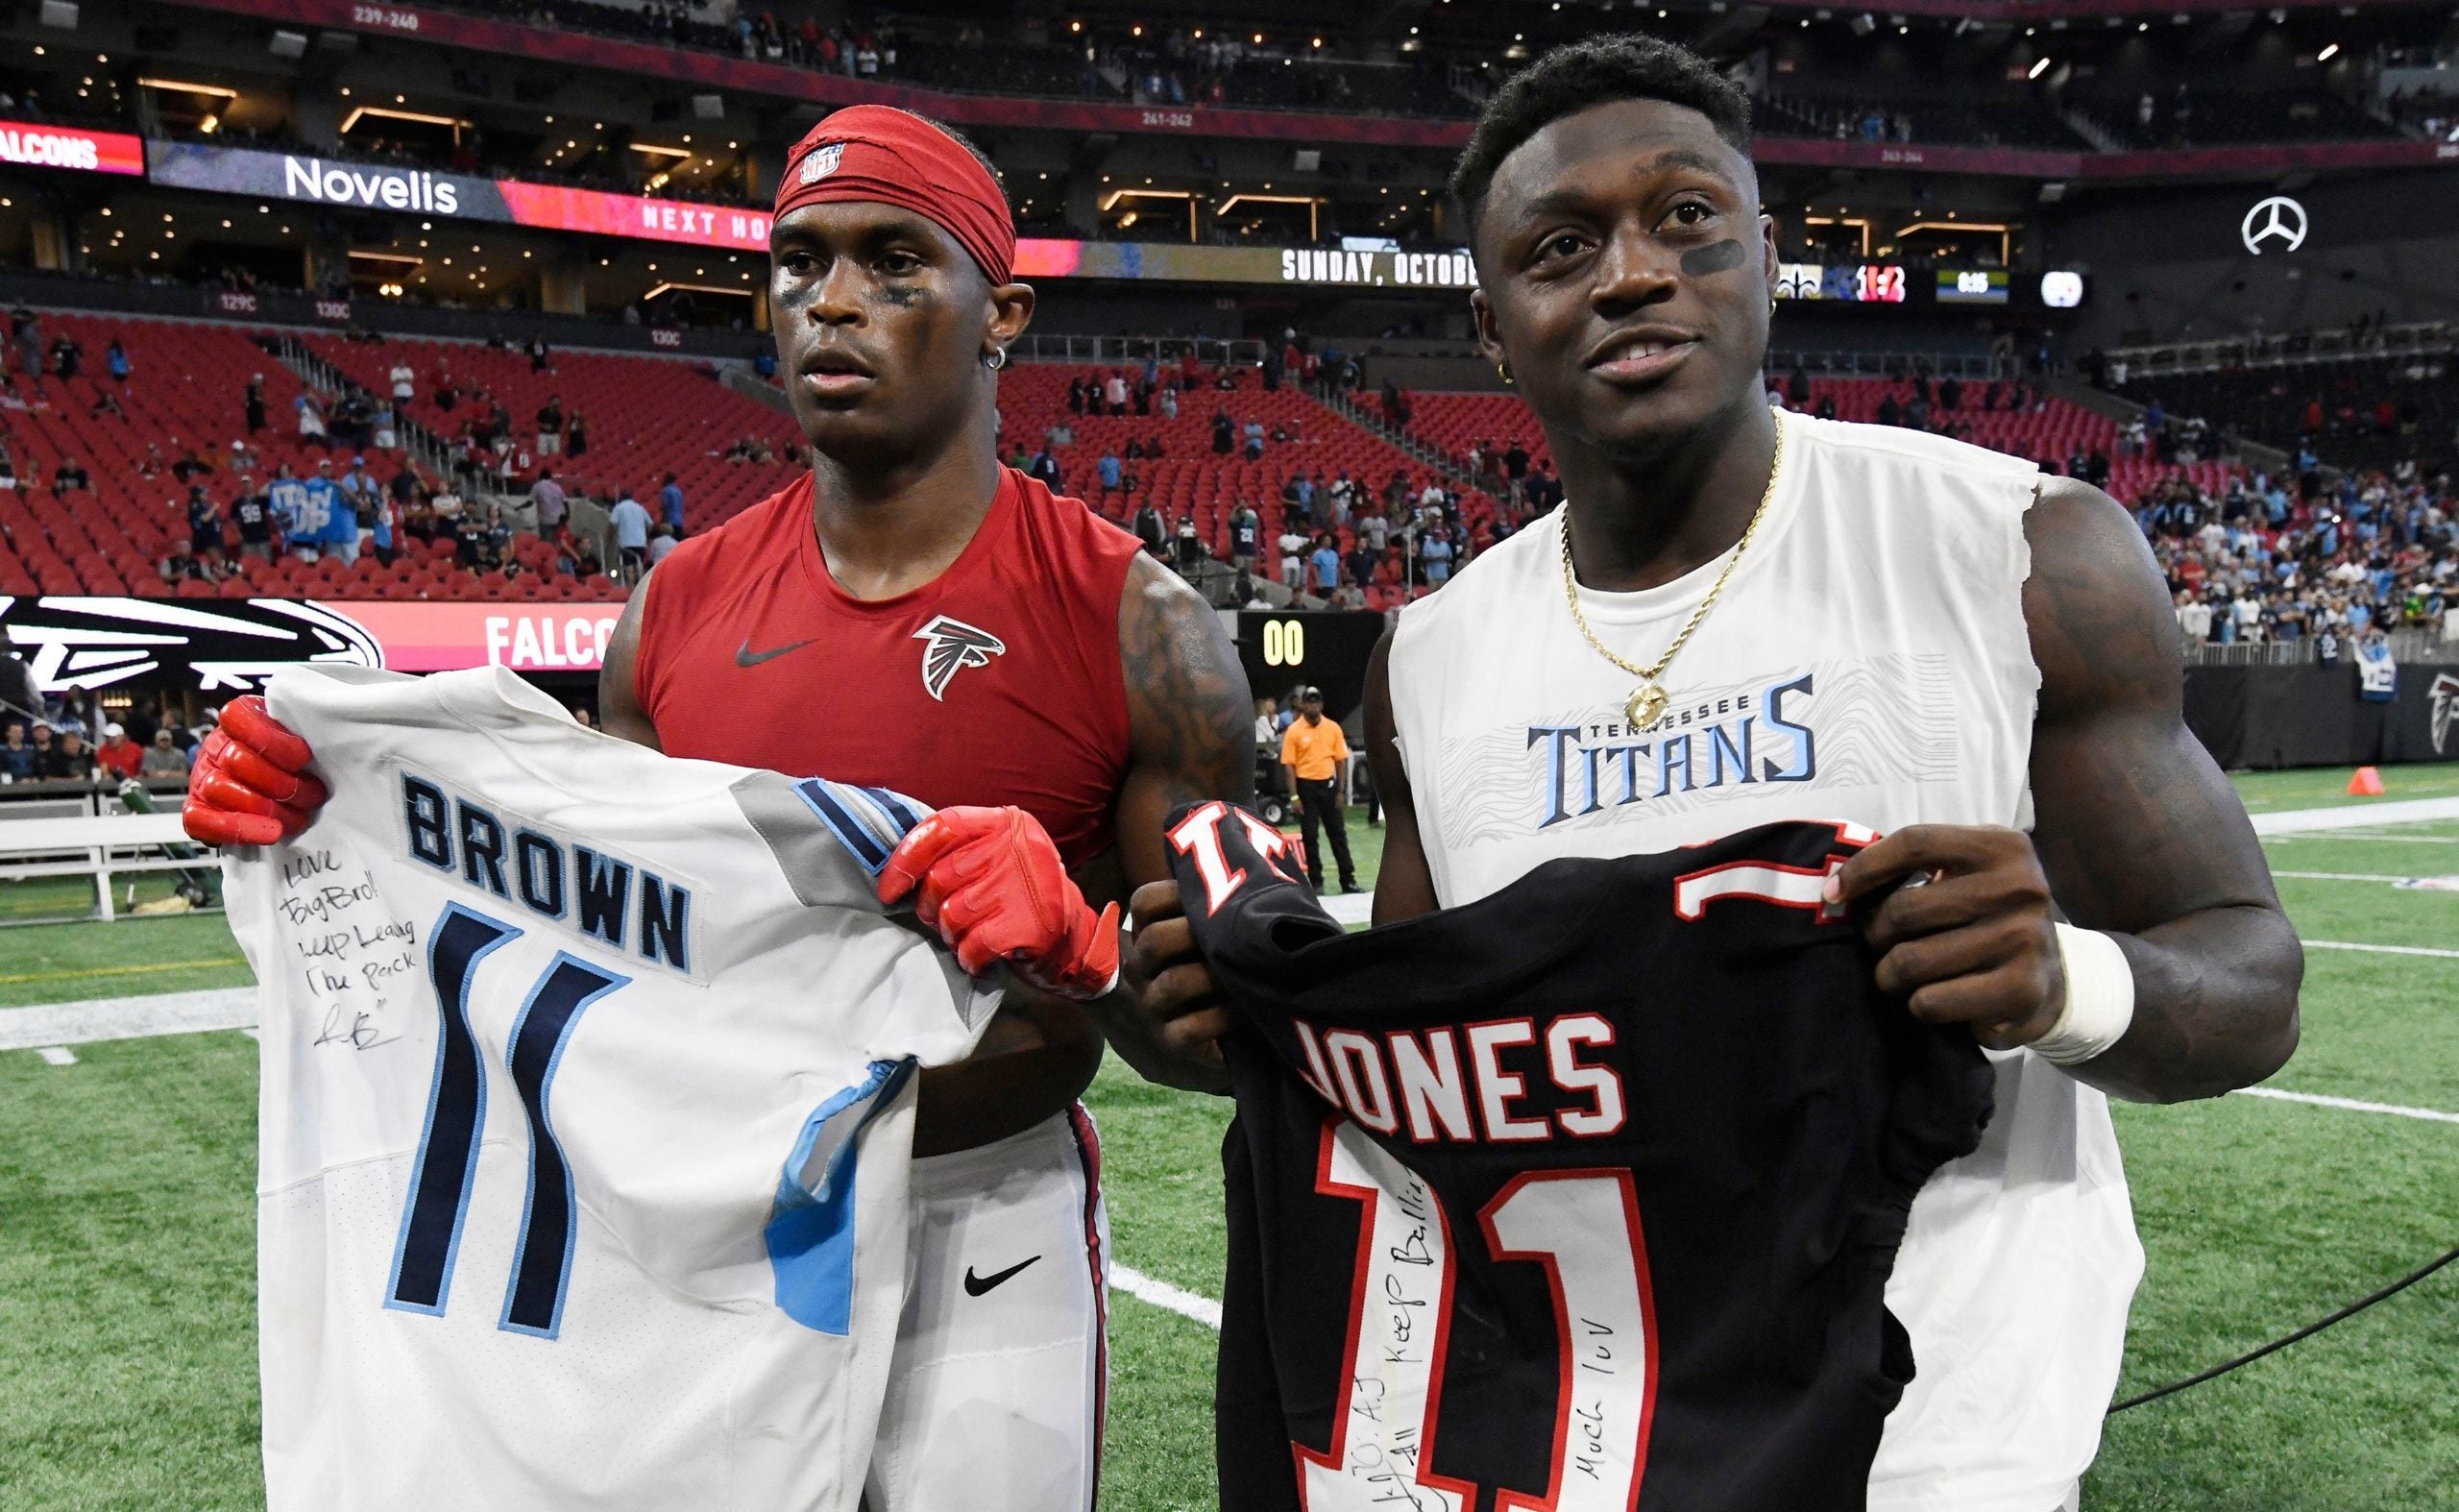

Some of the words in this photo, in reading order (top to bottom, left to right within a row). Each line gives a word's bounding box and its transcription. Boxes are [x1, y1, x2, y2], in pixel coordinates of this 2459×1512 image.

[284, 156, 458, 214] Novelis
[643, 205, 715, 235] NEXT
[731, 215, 772, 241] HO
[1282, 249, 1383, 286] SUNDAY,
[1263, 619, 1304, 667] 00
[1527, 673, 1815, 830] TITANS
[400, 770, 694, 974] BROWN
[382, 900, 633, 1340] 11
[1292, 1012, 1627, 1143] JONES
[1290, 1114, 1660, 1512] 11
